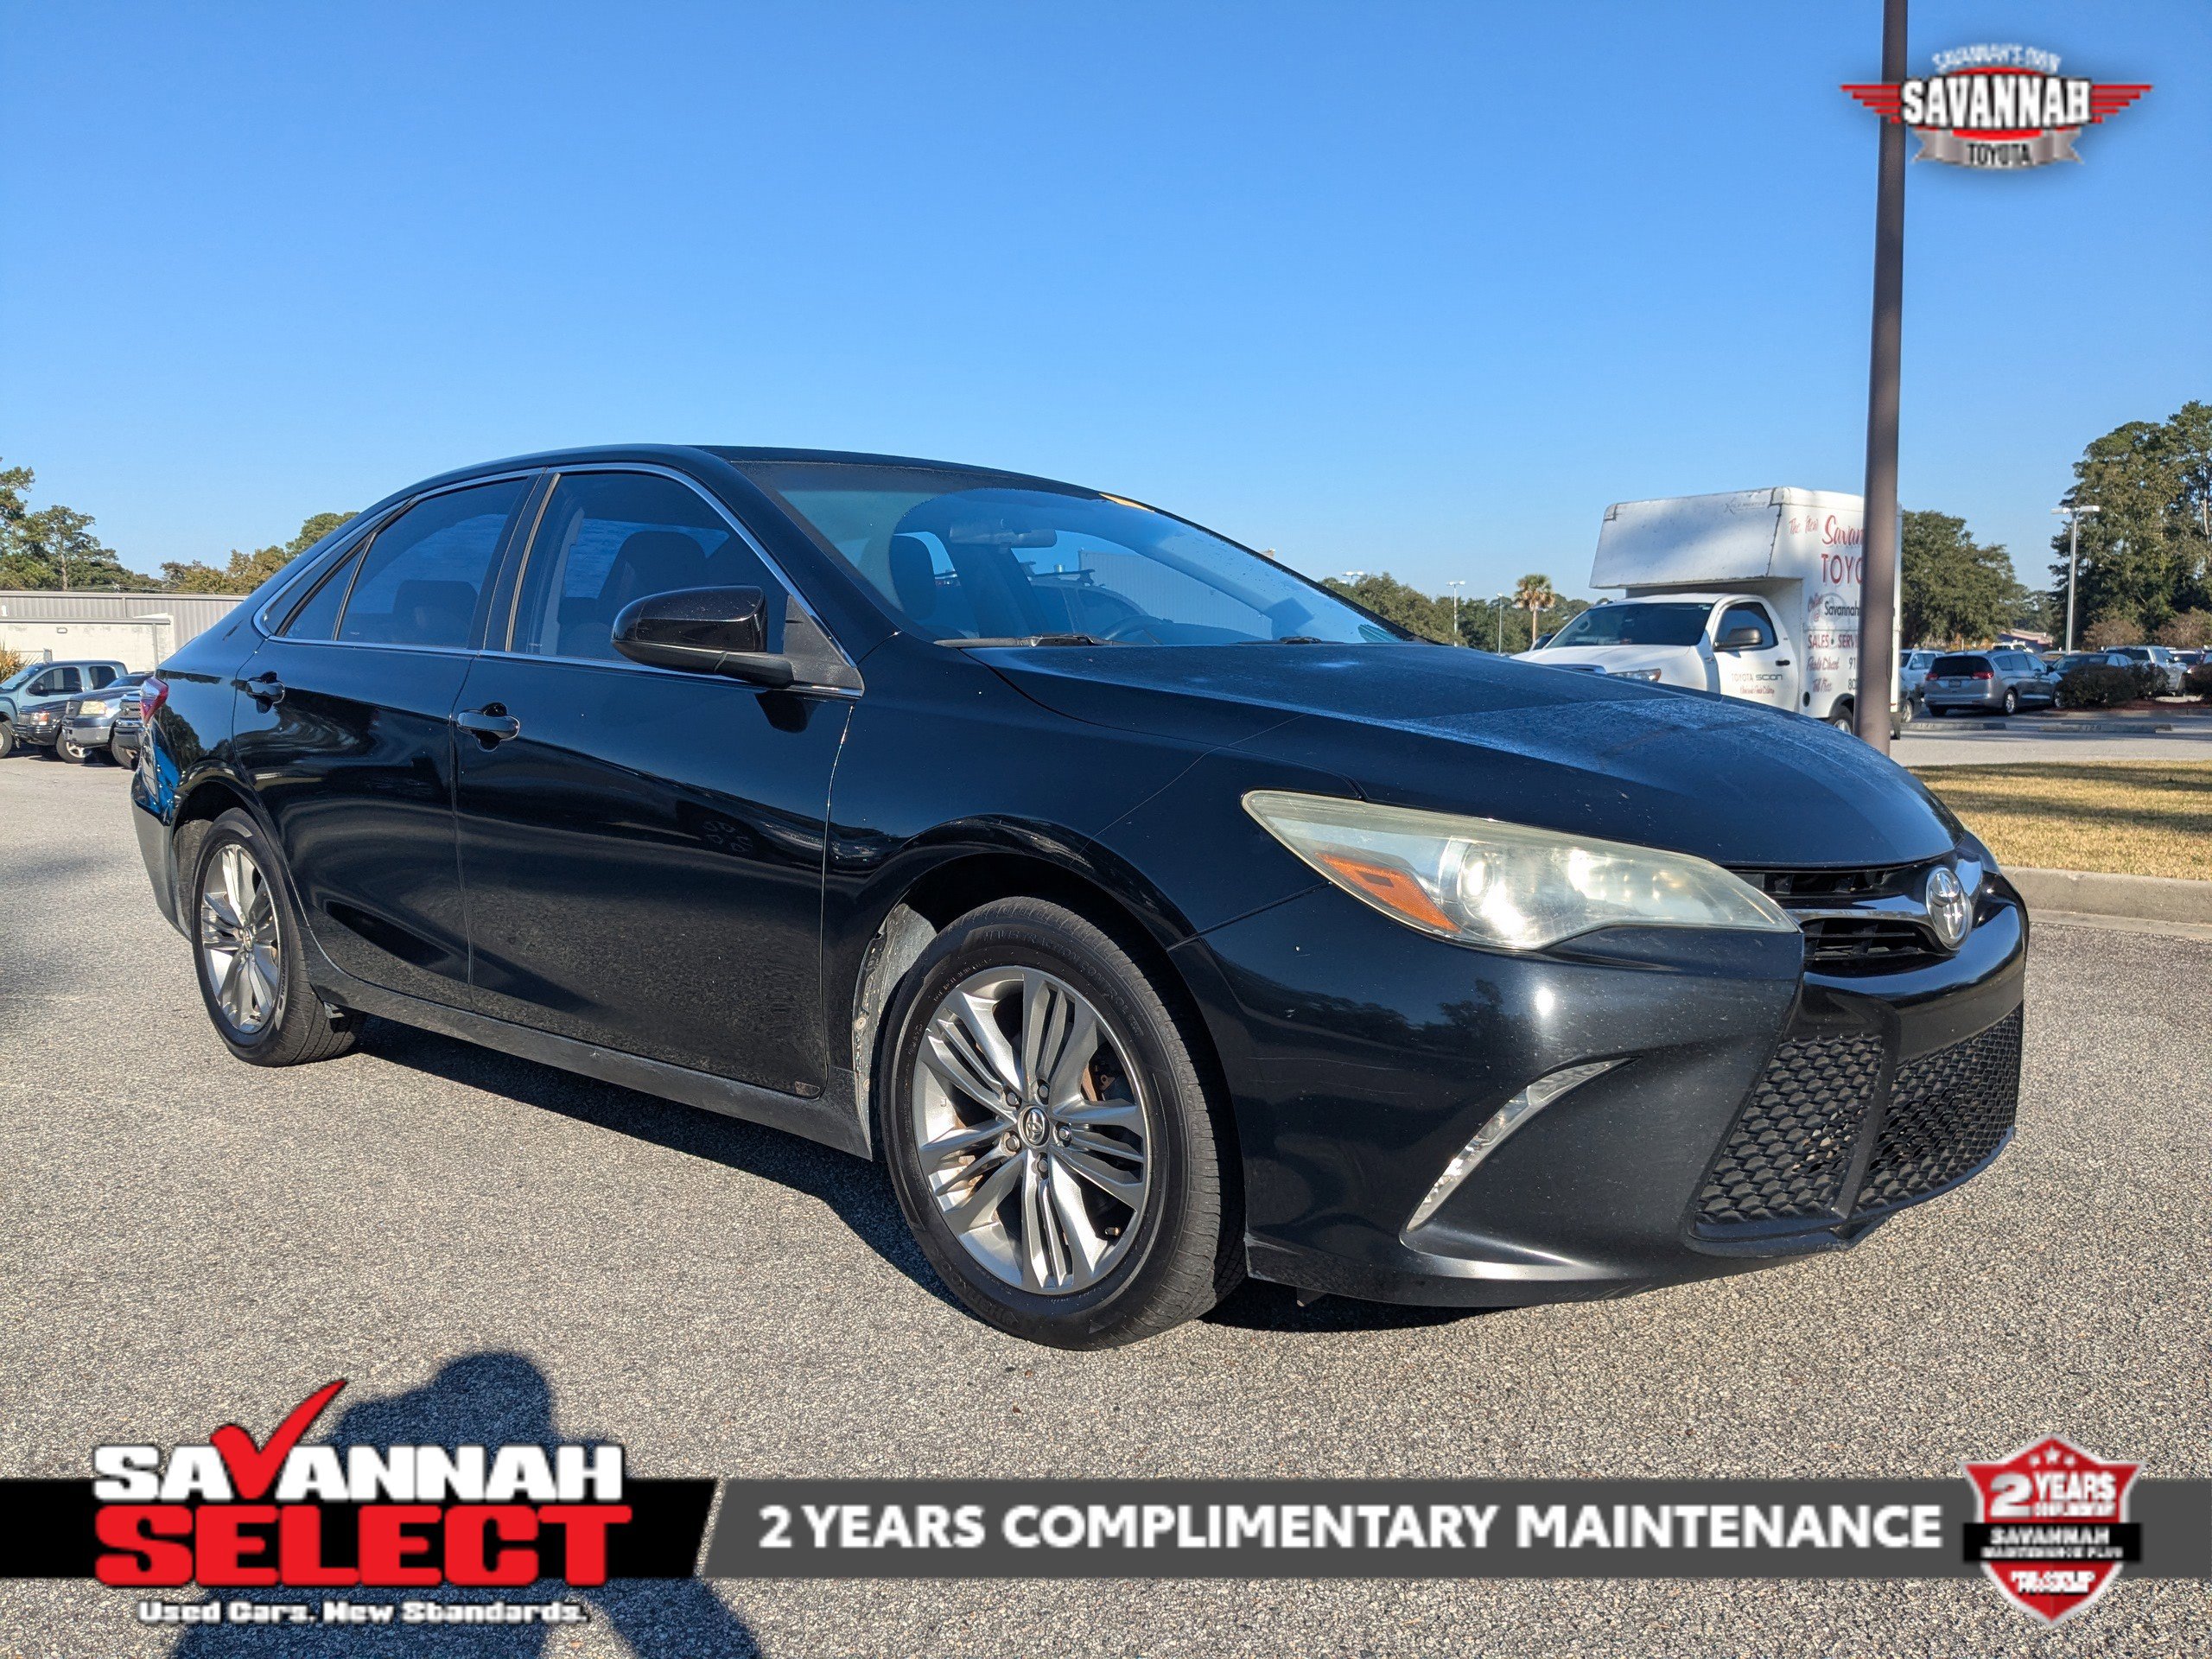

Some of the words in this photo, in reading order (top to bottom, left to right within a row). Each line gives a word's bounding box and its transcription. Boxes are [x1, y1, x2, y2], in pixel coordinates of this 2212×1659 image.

[1821, 514, 1864, 545] Savan
[1821, 553, 1863, 584] TOYO
[1808, 634, 1829, 649] SALES
